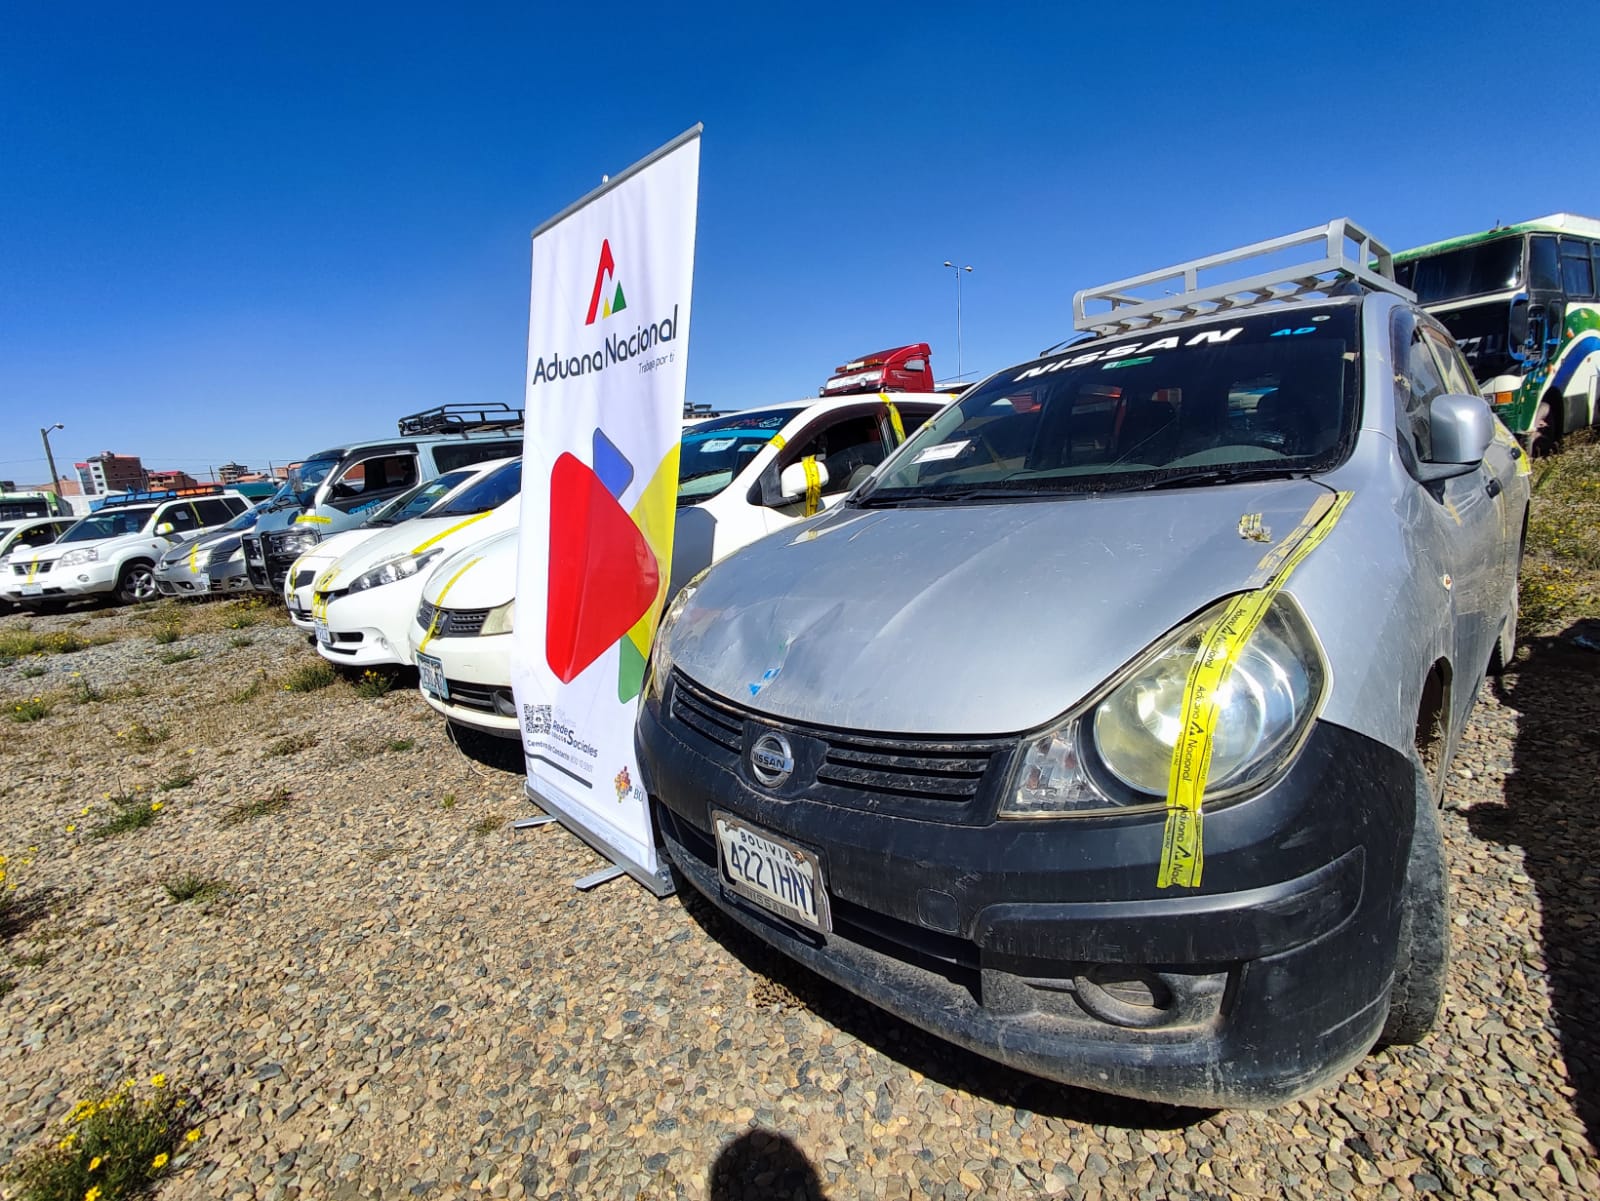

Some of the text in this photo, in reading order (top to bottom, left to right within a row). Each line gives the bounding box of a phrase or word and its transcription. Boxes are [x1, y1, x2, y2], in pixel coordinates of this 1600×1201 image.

[532, 304, 679, 385] Aduana Nacional
[1013, 327, 1244, 382] NISSAN
[752, 751, 785, 769] NISSAN
[1183, 738, 1198, 782] Nacional
[740, 831, 793, 862] BOLIVIA
[731, 841, 819, 917] 4221HNY
